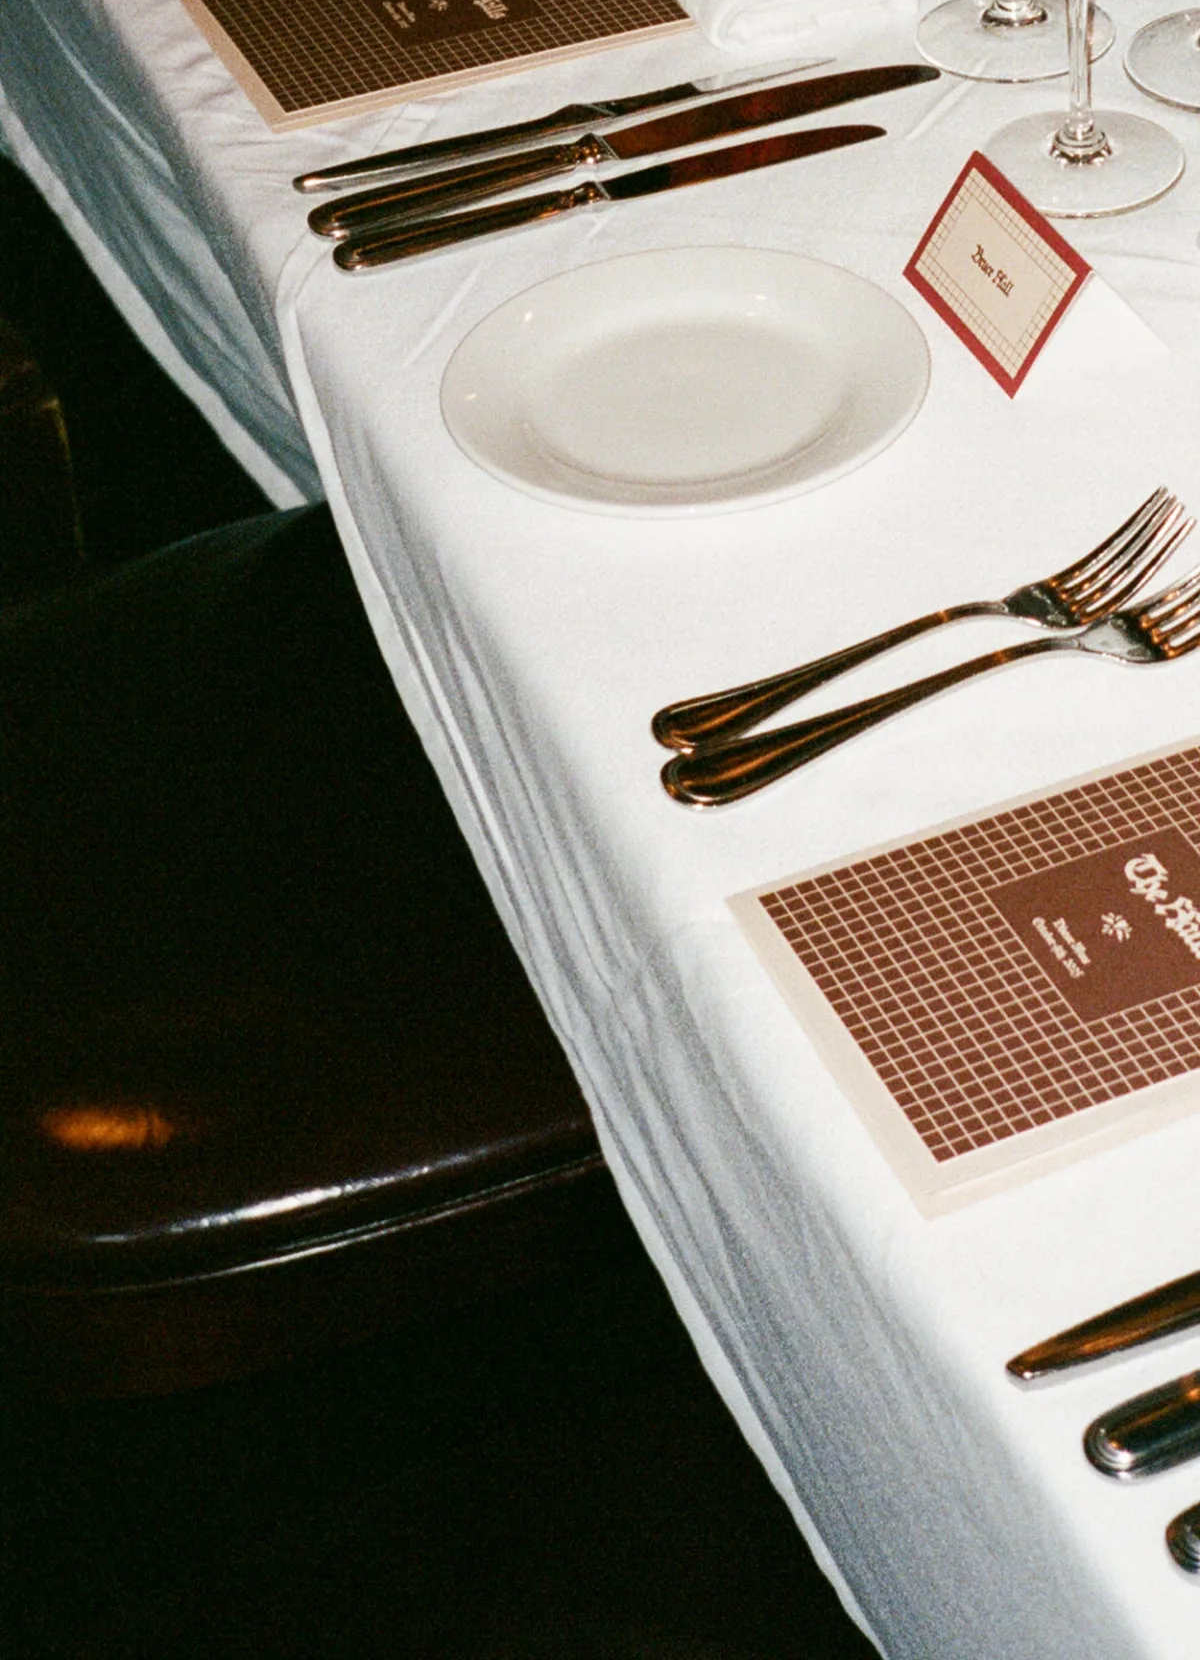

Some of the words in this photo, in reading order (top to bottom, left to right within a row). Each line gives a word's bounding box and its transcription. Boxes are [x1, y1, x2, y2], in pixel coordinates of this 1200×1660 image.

[970, 243, 995, 278] Bruce
[992, 269, 1015, 297] Hall
[1124, 853, 1169, 902] The
